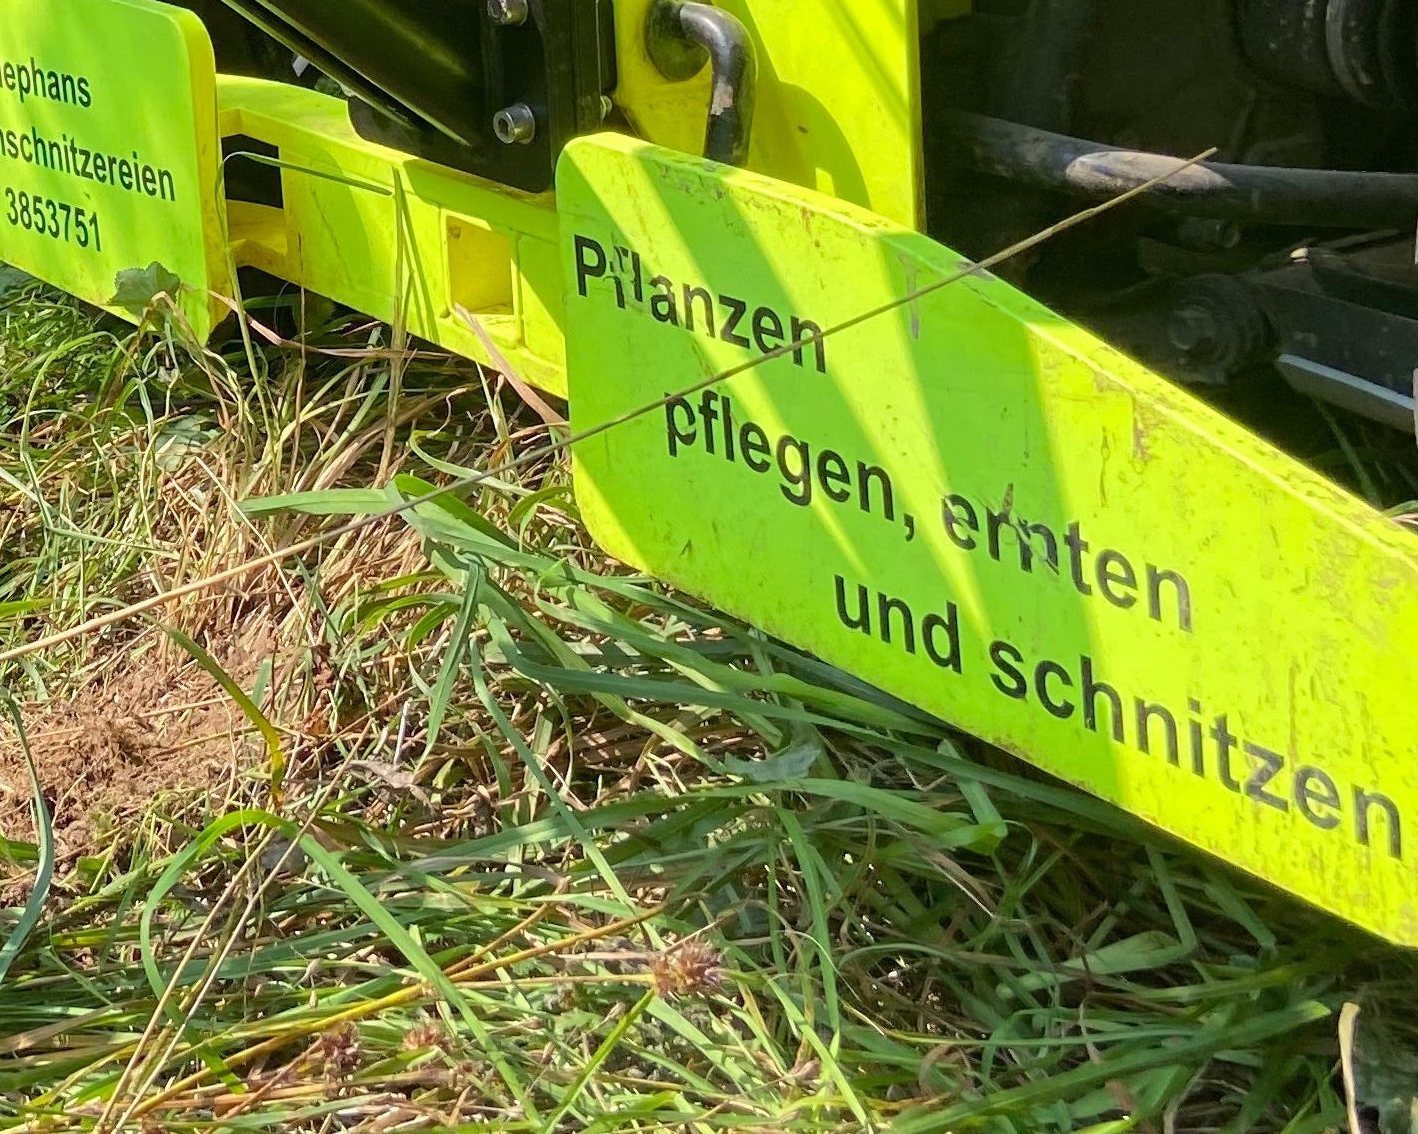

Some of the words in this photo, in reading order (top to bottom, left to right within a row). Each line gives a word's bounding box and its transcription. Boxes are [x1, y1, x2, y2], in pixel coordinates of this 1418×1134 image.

[4, 186, 102, 252] 3853751
[664, 388, 916, 542] pflegen,
[941, 493, 1194, 634] ernten
[834, 574, 963, 675] und
[989, 640, 1404, 861] schnitzen
